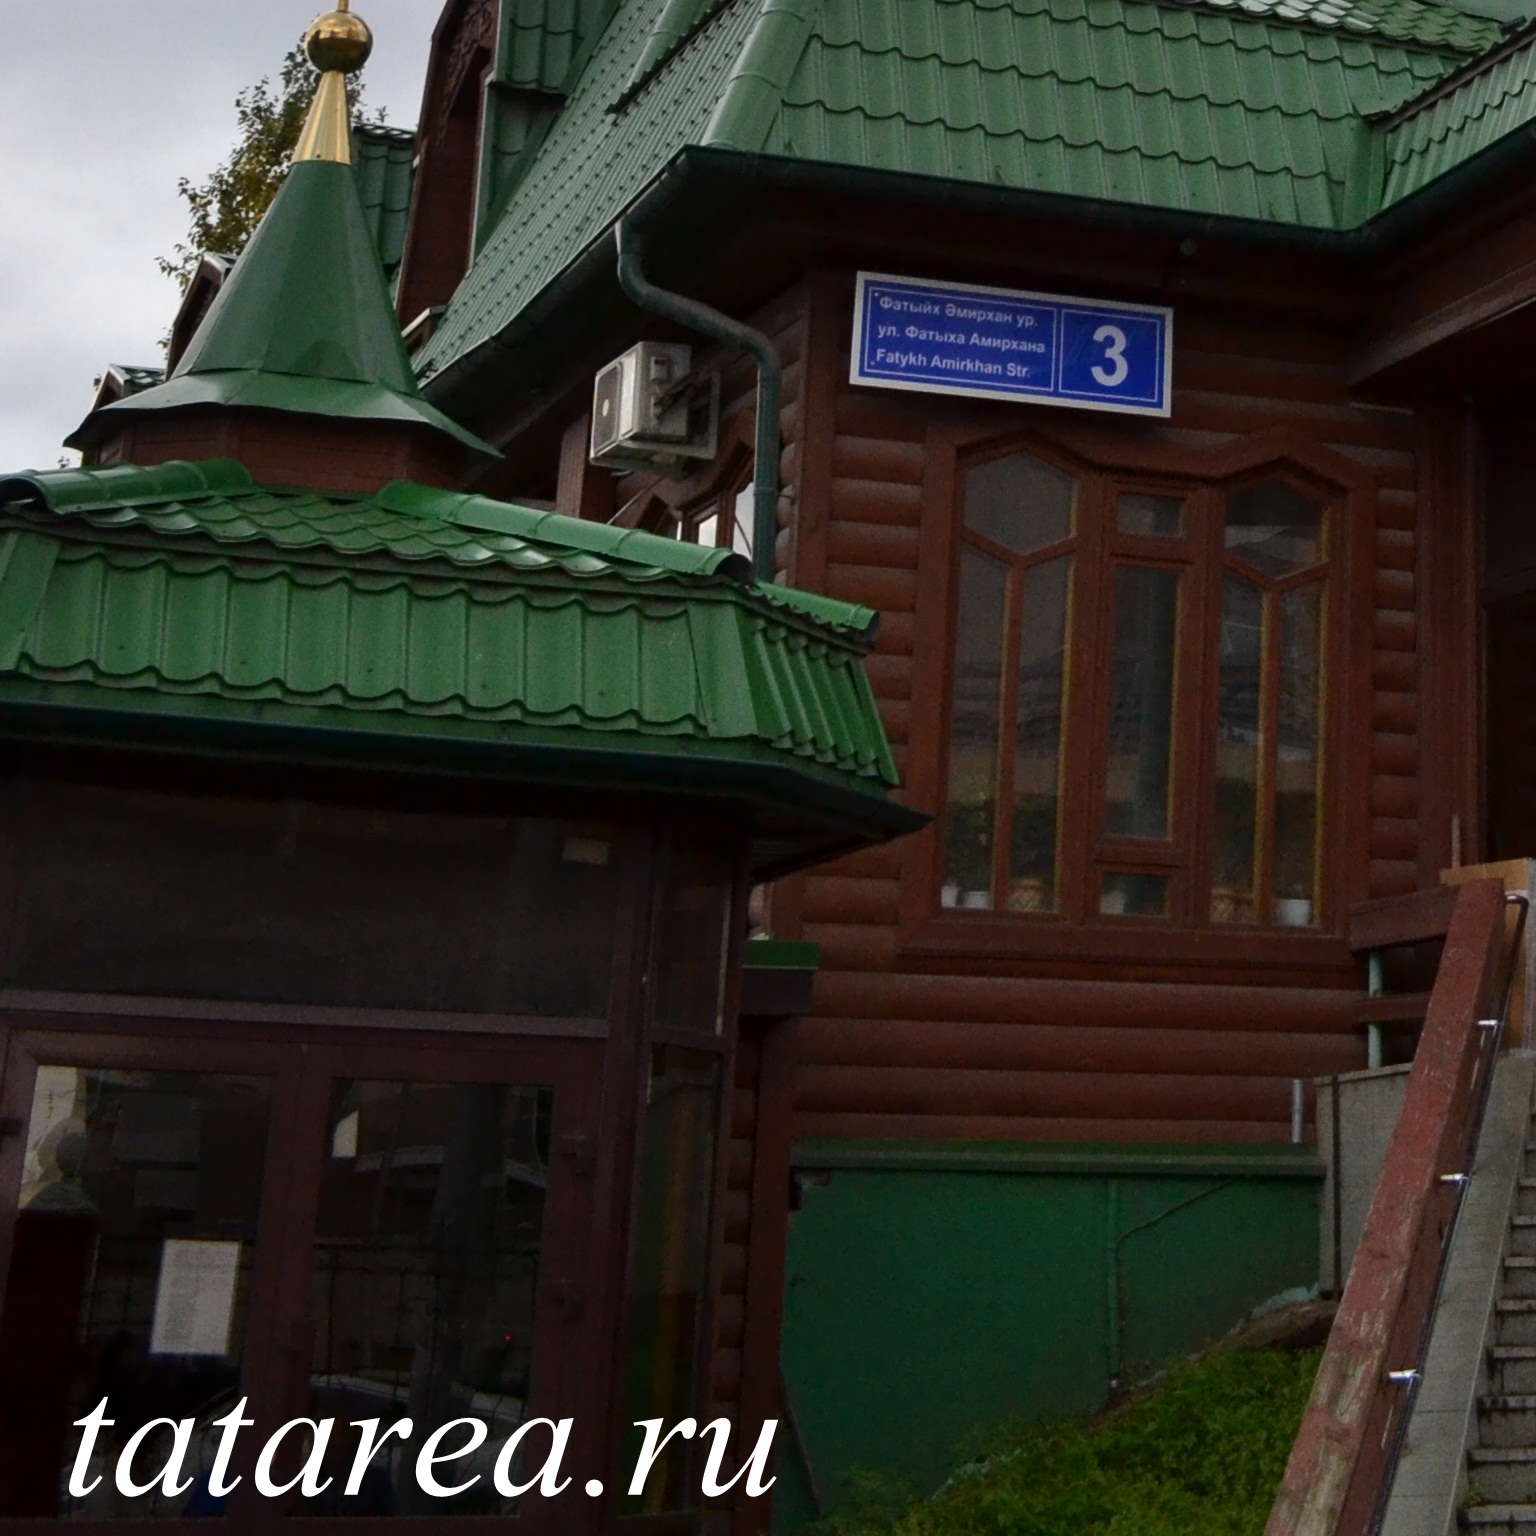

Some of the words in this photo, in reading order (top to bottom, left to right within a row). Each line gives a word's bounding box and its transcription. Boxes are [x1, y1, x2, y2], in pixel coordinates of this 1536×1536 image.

[880, 297, 940, 315] Фатыйх
[945, 304, 1012, 323] Әмирхан
[1016, 314, 1038, 328] ур.
[878, 325, 900, 338] ул.
[905, 326, 965, 344] Фатыха
[969, 333, 1045, 353] Амирхана
[876, 348, 927, 368] Fatykh
[930, 355, 1002, 375] Amirkhan
[1006, 362, 1031, 378] Str.
[1091, 325, 1128, 387] 3
